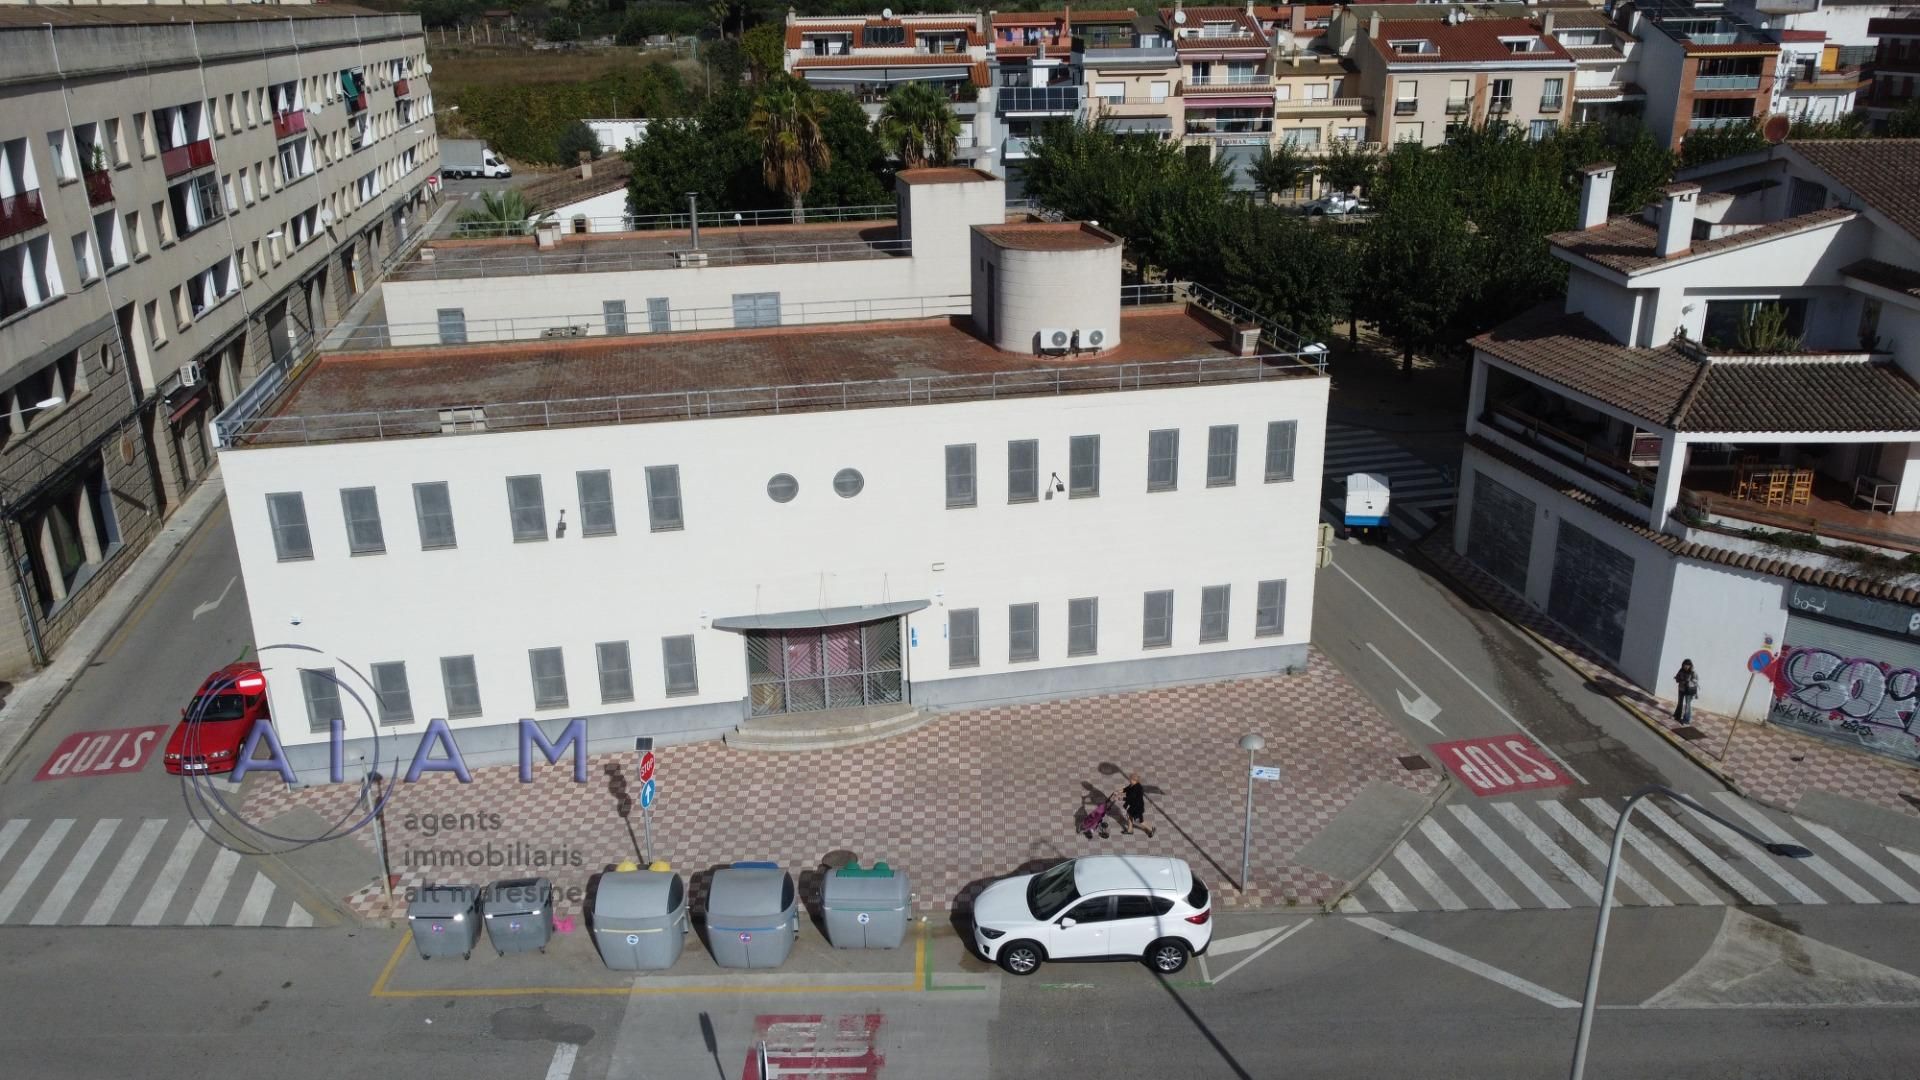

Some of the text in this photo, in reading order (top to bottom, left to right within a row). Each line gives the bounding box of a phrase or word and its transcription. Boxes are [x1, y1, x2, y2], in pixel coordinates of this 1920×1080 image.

[48, 731, 156, 775] STOP
[640, 757, 654, 777] STOP
[1451, 740, 1556, 788] STOP
